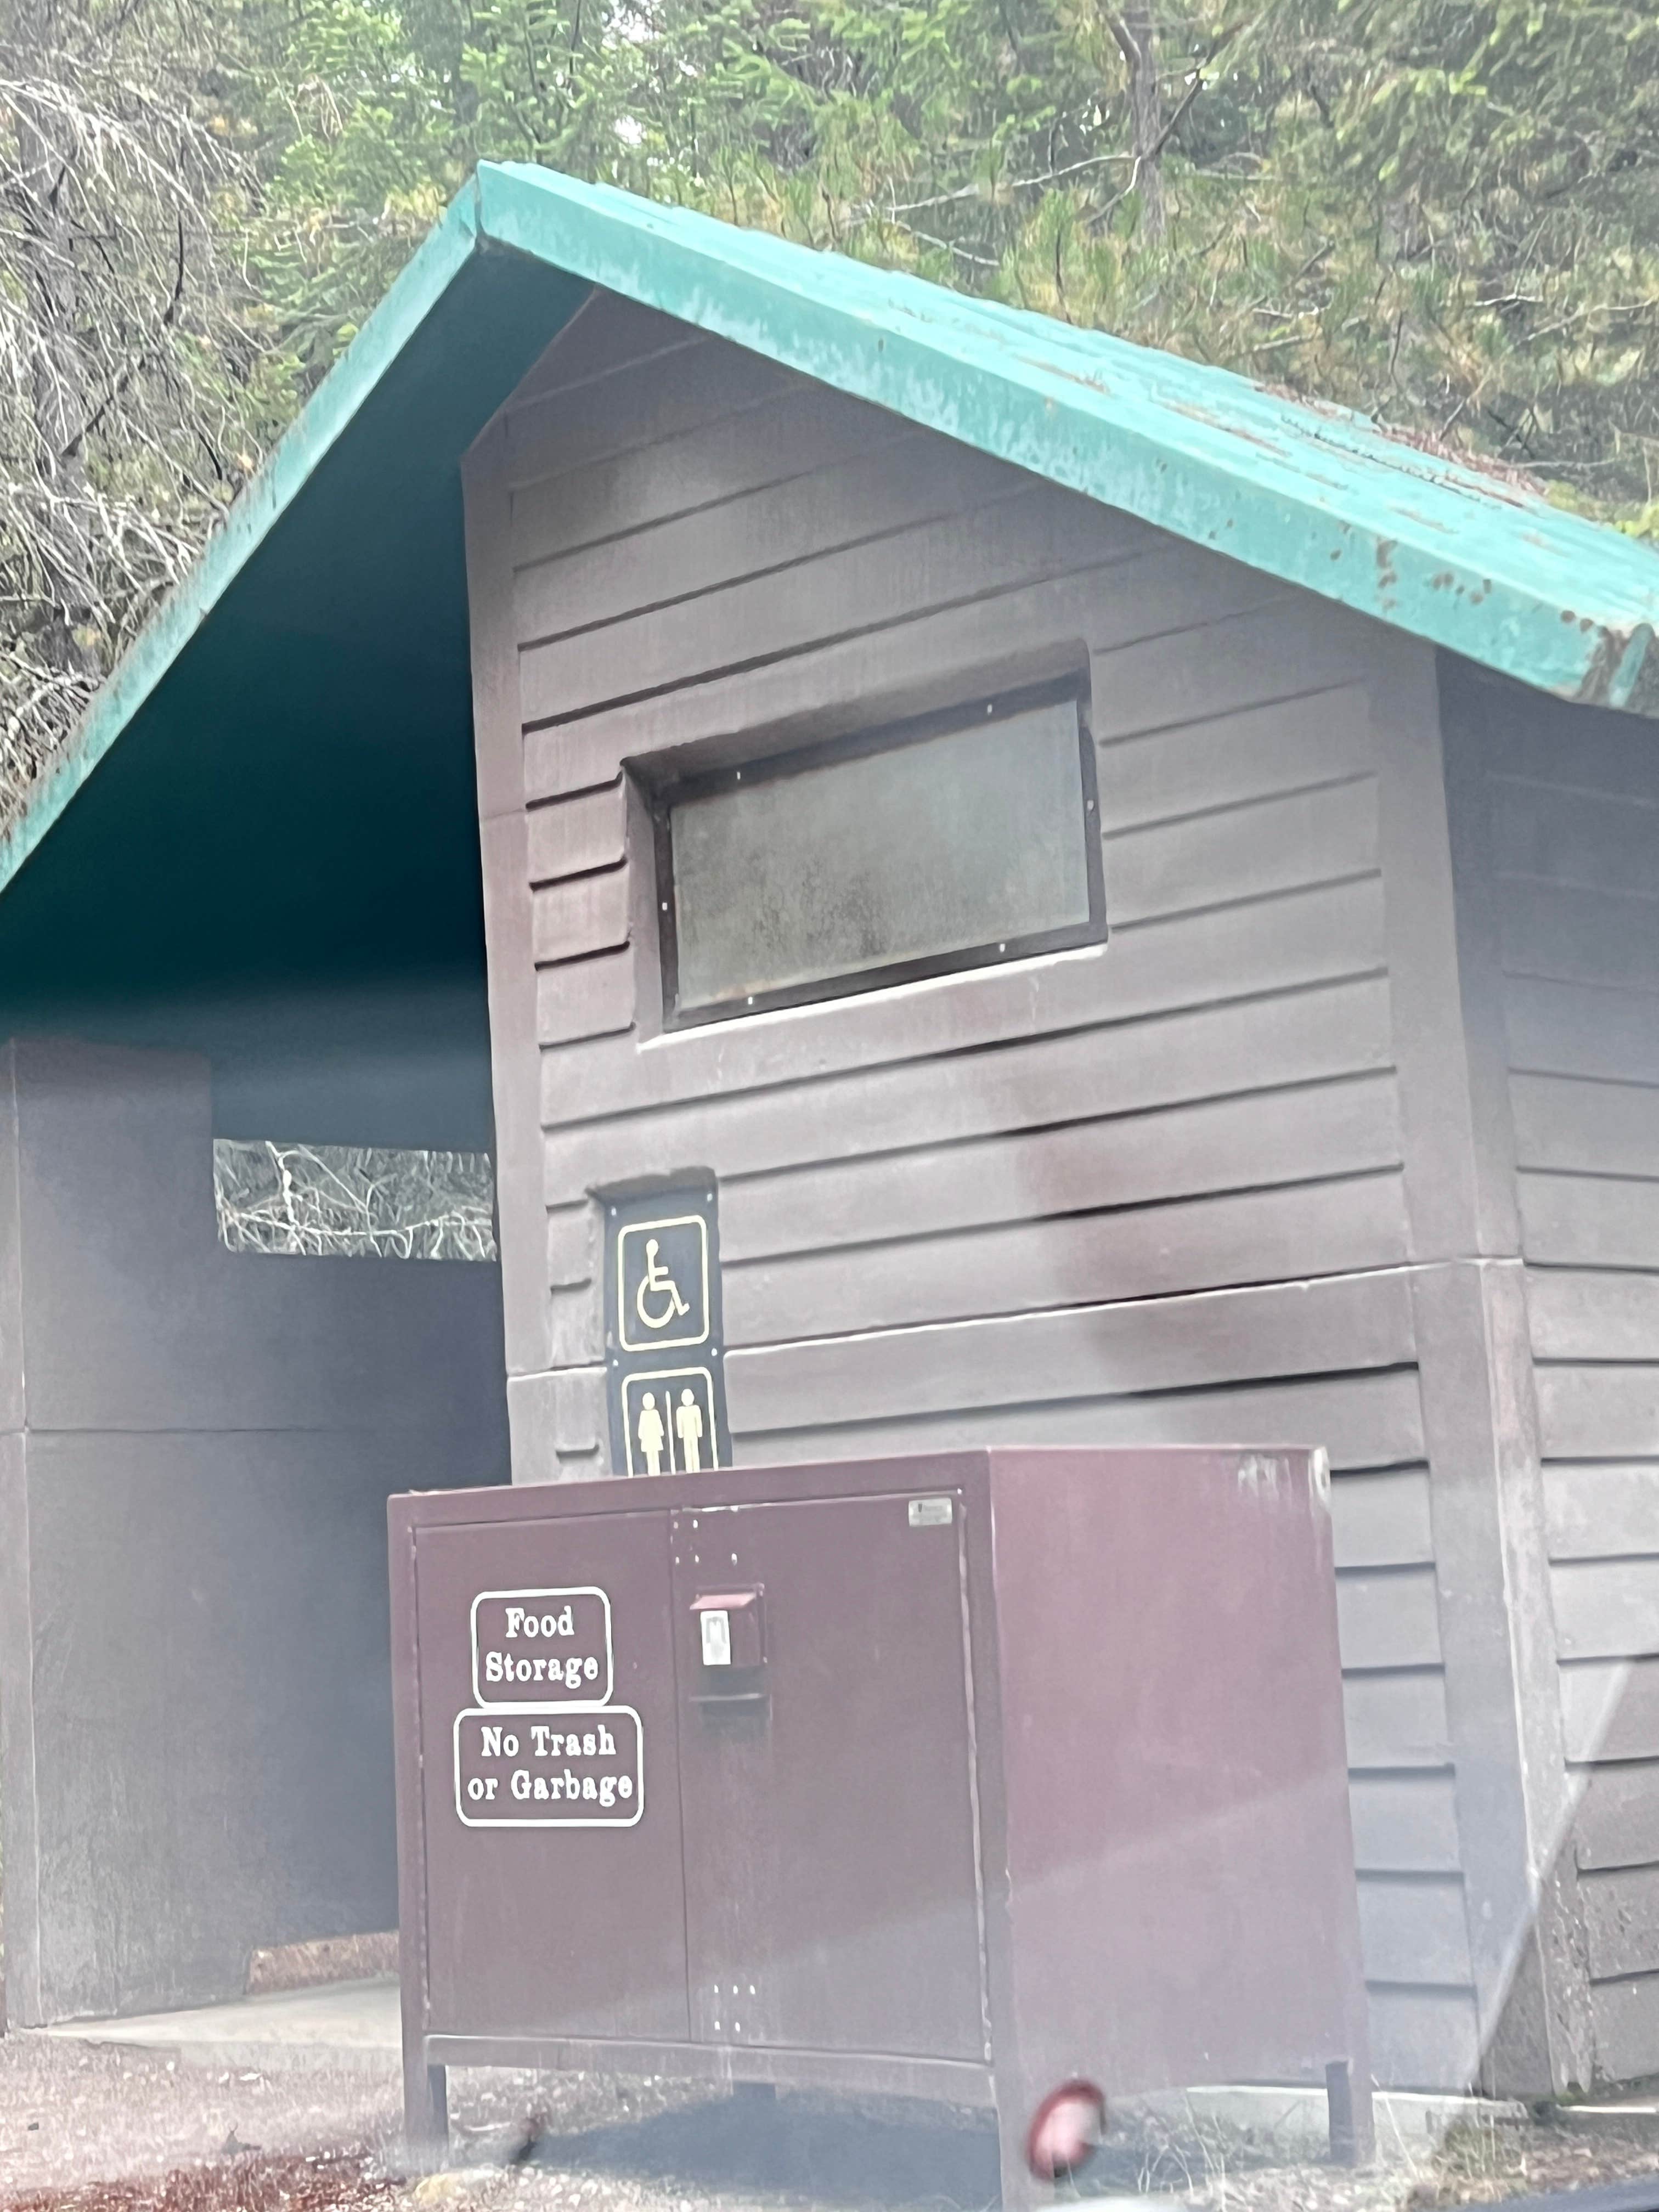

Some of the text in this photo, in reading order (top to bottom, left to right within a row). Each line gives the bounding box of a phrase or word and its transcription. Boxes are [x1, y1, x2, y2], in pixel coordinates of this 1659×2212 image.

[505, 1605, 575, 1638] Food
[486, 1651, 599, 1689] Storage
[481, 1724, 616, 1757] No Trash
[467, 1769, 633, 1807] or Garbage
